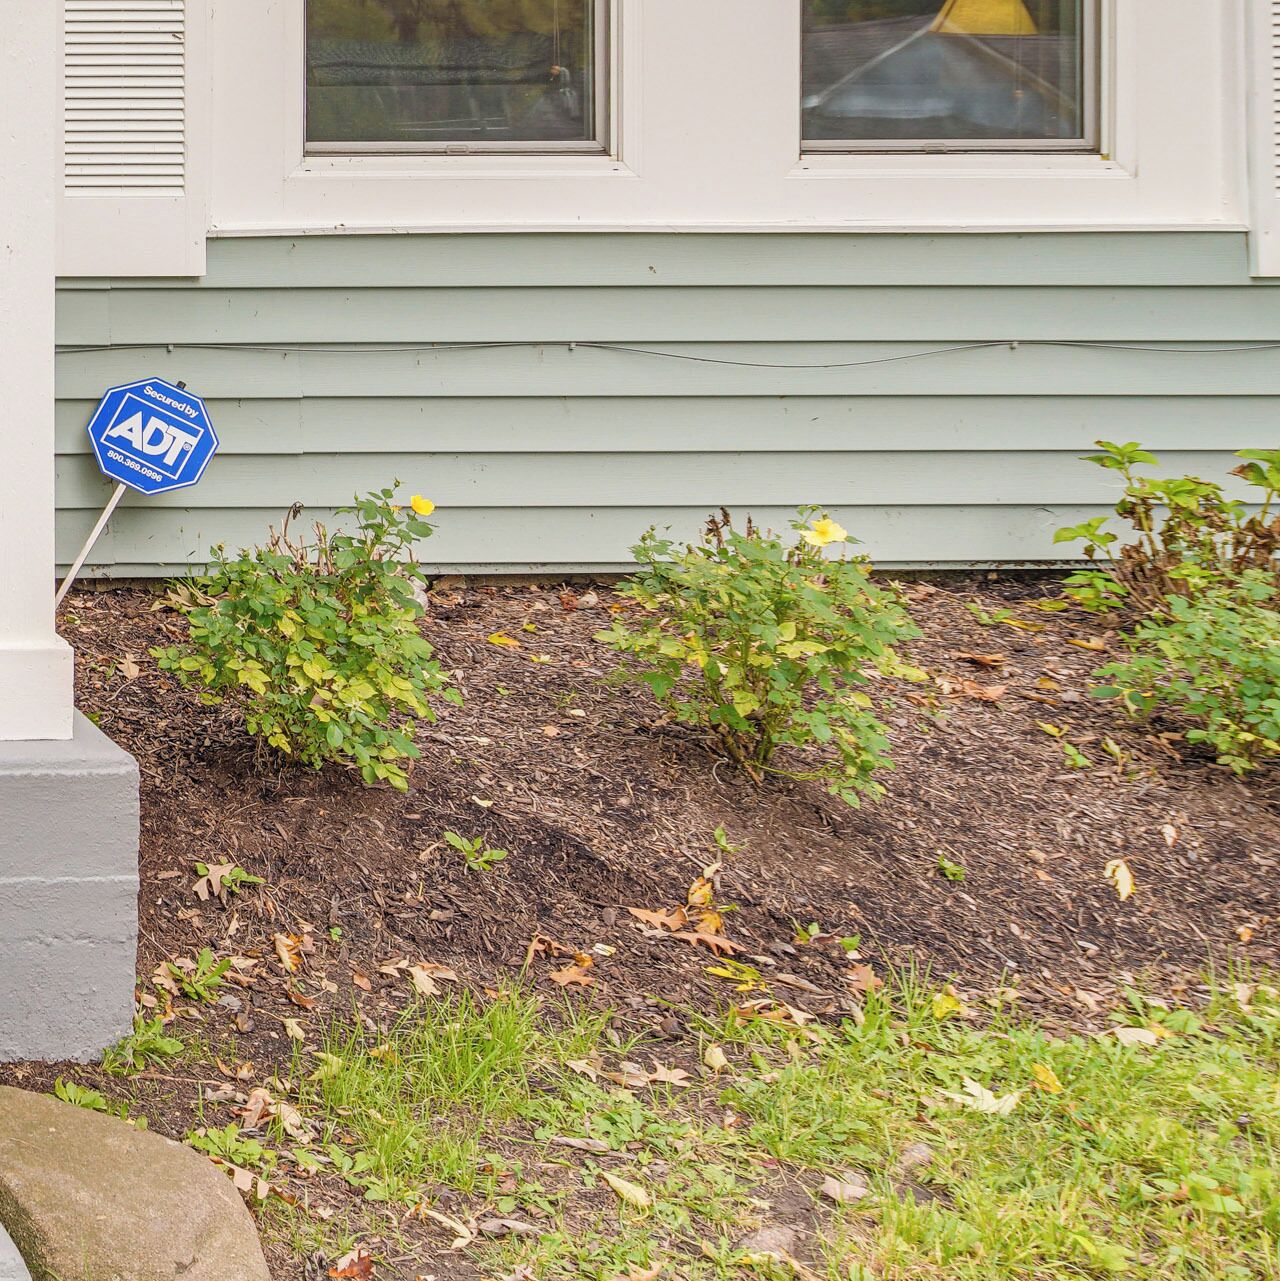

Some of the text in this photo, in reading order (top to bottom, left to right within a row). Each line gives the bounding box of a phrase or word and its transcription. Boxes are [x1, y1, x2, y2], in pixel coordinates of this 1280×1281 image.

[143, 385, 199, 419] Secured by
[107, 411, 197, 466] ADT
[107, 450, 163, 482] 800.369.0996
